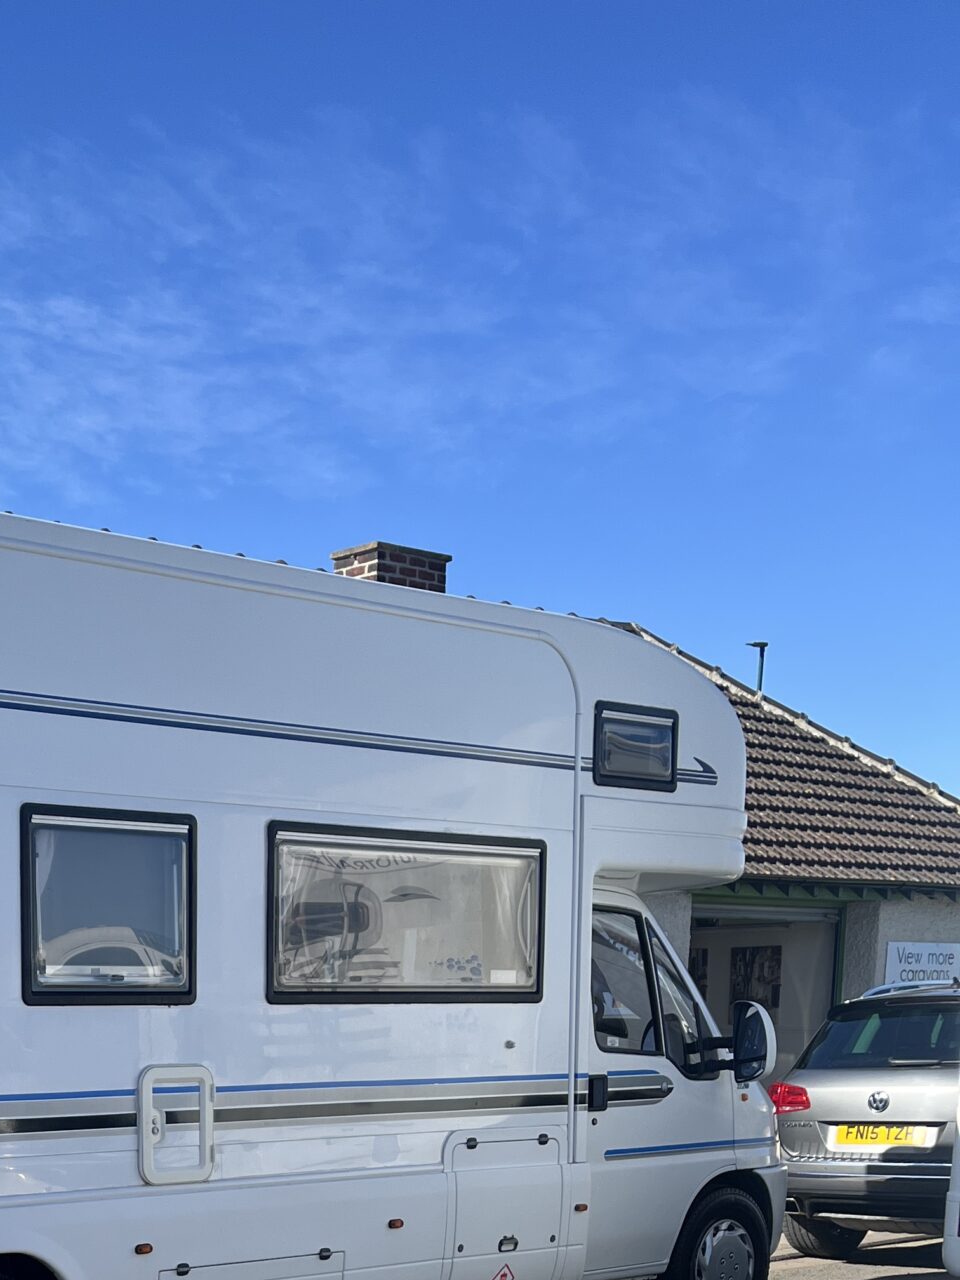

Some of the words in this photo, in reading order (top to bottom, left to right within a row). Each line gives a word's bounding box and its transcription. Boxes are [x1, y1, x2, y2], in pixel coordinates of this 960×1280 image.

[897, 946, 923, 965] View
[927, 952, 955, 965] more
[900, 969, 950, 982] caravans
[845, 1125, 879, 1140] FN15
